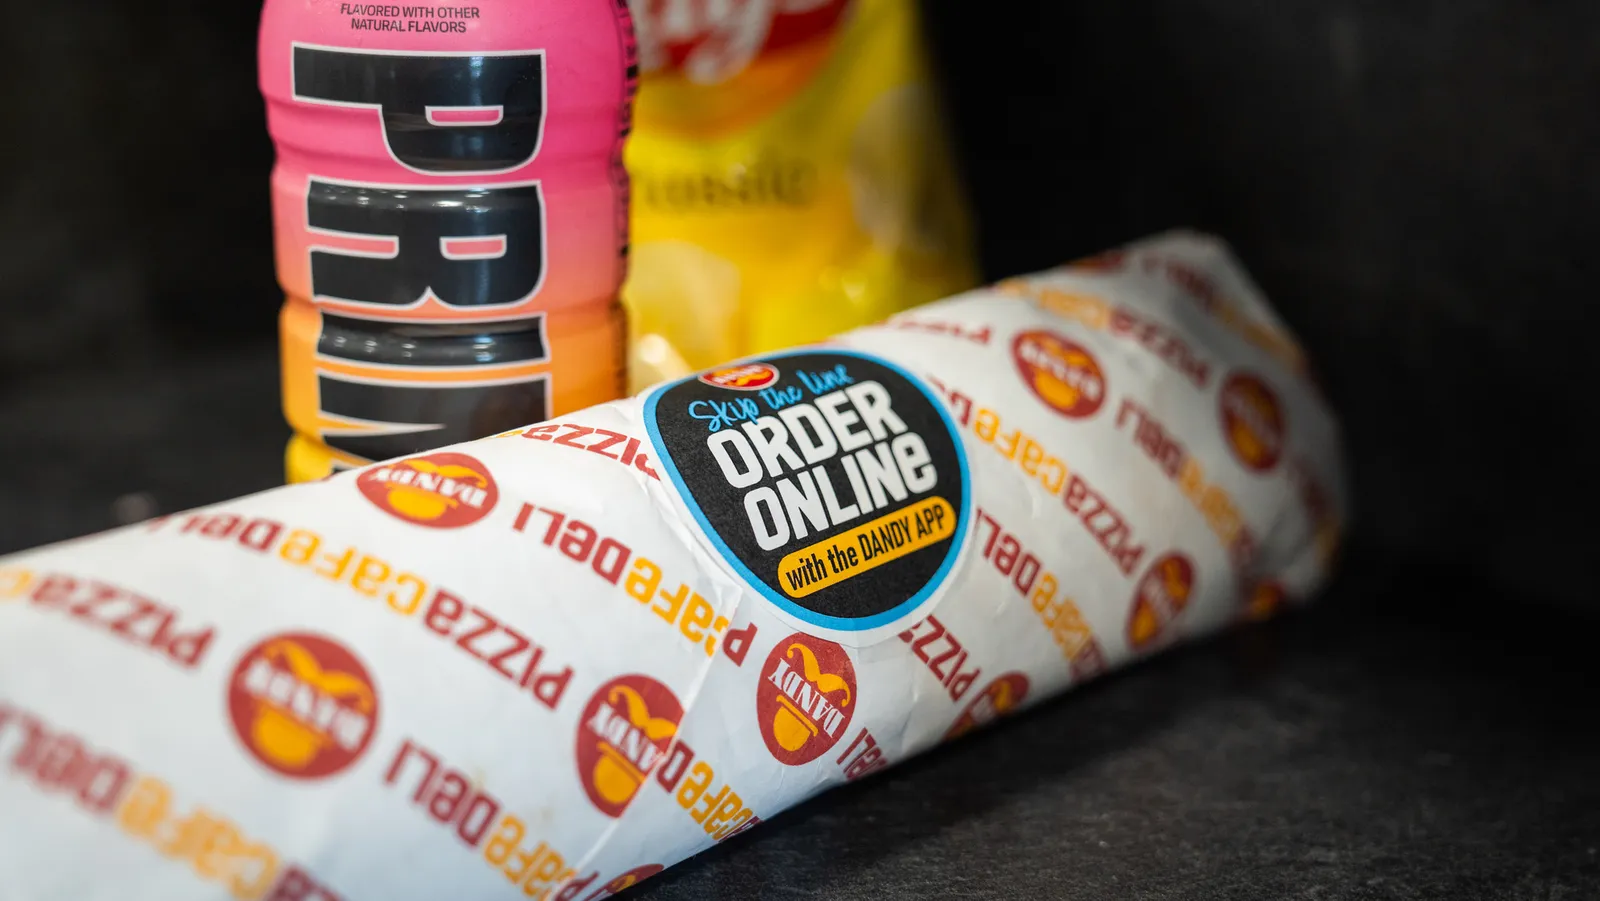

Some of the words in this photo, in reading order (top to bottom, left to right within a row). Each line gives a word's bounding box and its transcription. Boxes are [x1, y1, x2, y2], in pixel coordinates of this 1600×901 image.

[340, 3, 400, 17] FLAVORED
[402, 7, 435, 18] WITH
[437, 7, 480, 19] OTHER
[351, 18, 406, 32] NATURAL
[408, 20, 467, 33] FLAVORS
[688, 397, 760, 433] Skip
[758, 384, 803, 409] the
[796, 363, 855, 395] line
[706, 380, 908, 489] ORDER
[375, 466, 488, 509] DANDY
[786, 553, 828, 591] with
[827, 545, 859, 574] the
[857, 515, 912, 561] DANDY
[915, 504, 945, 540] APP
[767, 657, 845, 739] DANDY
[585, 702, 669, 772] ANDY
